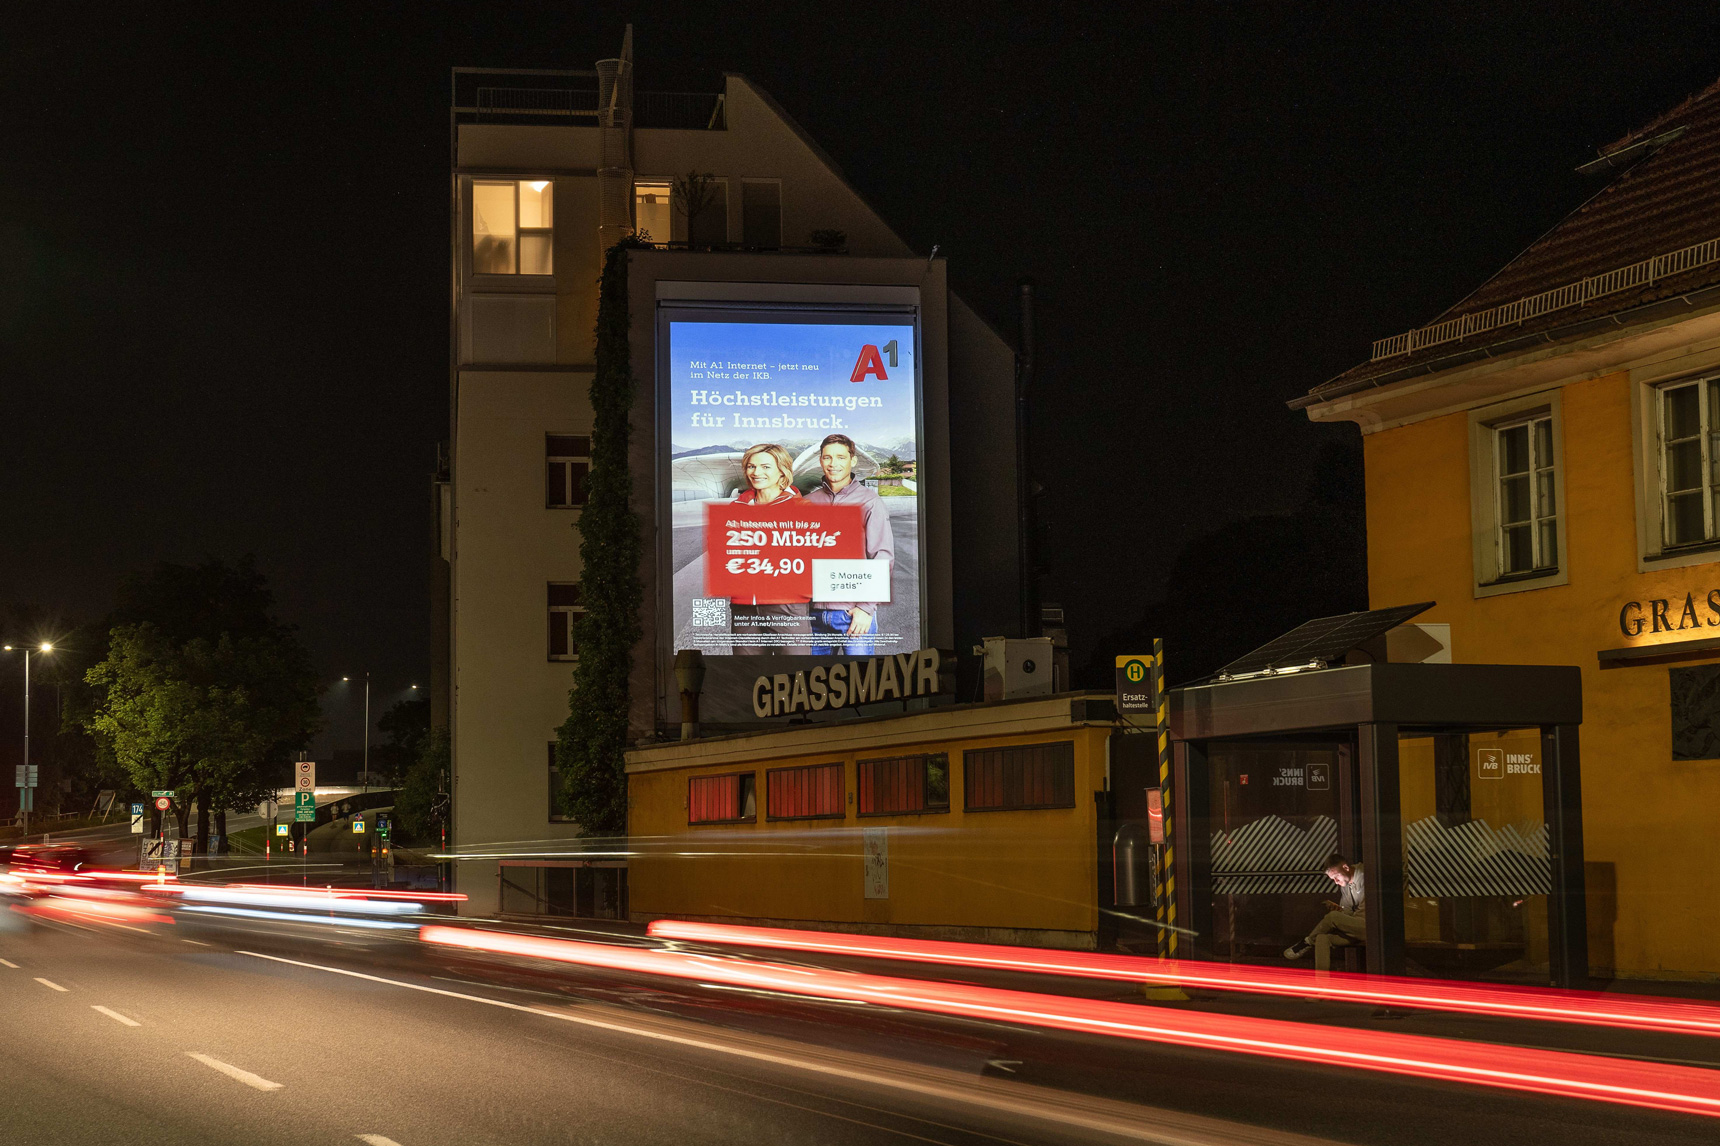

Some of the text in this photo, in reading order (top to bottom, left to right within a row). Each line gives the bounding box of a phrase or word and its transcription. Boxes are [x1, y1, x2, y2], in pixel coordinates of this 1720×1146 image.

[690, 361, 707, 369] Mit
[710, 361, 724, 370] A1
[727, 361, 767, 370] Internet
[778, 363, 799, 372] jetzt
[850, 340, 898, 383] A1
[690, 371, 773, 380] im Netz der IKB.
[690, 390, 883, 411] Höchstleistungen
[691, 412, 849, 429] für Innsbruck.
[740, 520, 777, 529] Internet
[779, 521, 794, 529] mit
[795, 521, 808, 529] bis
[726, 530, 768, 546] 250
[838, 572, 872, 580] Monate
[1130, 665, 1141, 679] H
[753, 648, 940, 718] GRASSMAYR
[1122, 693, 1149, 701] Ersatz-
[1506, 754, 1533, 764] INNS'
[1483, 762, 1499, 770] IVB
[1507, 764, 1541, 774] BRUCK
[301, 792, 310, 806] P
[132, 805, 143, 814] 174
